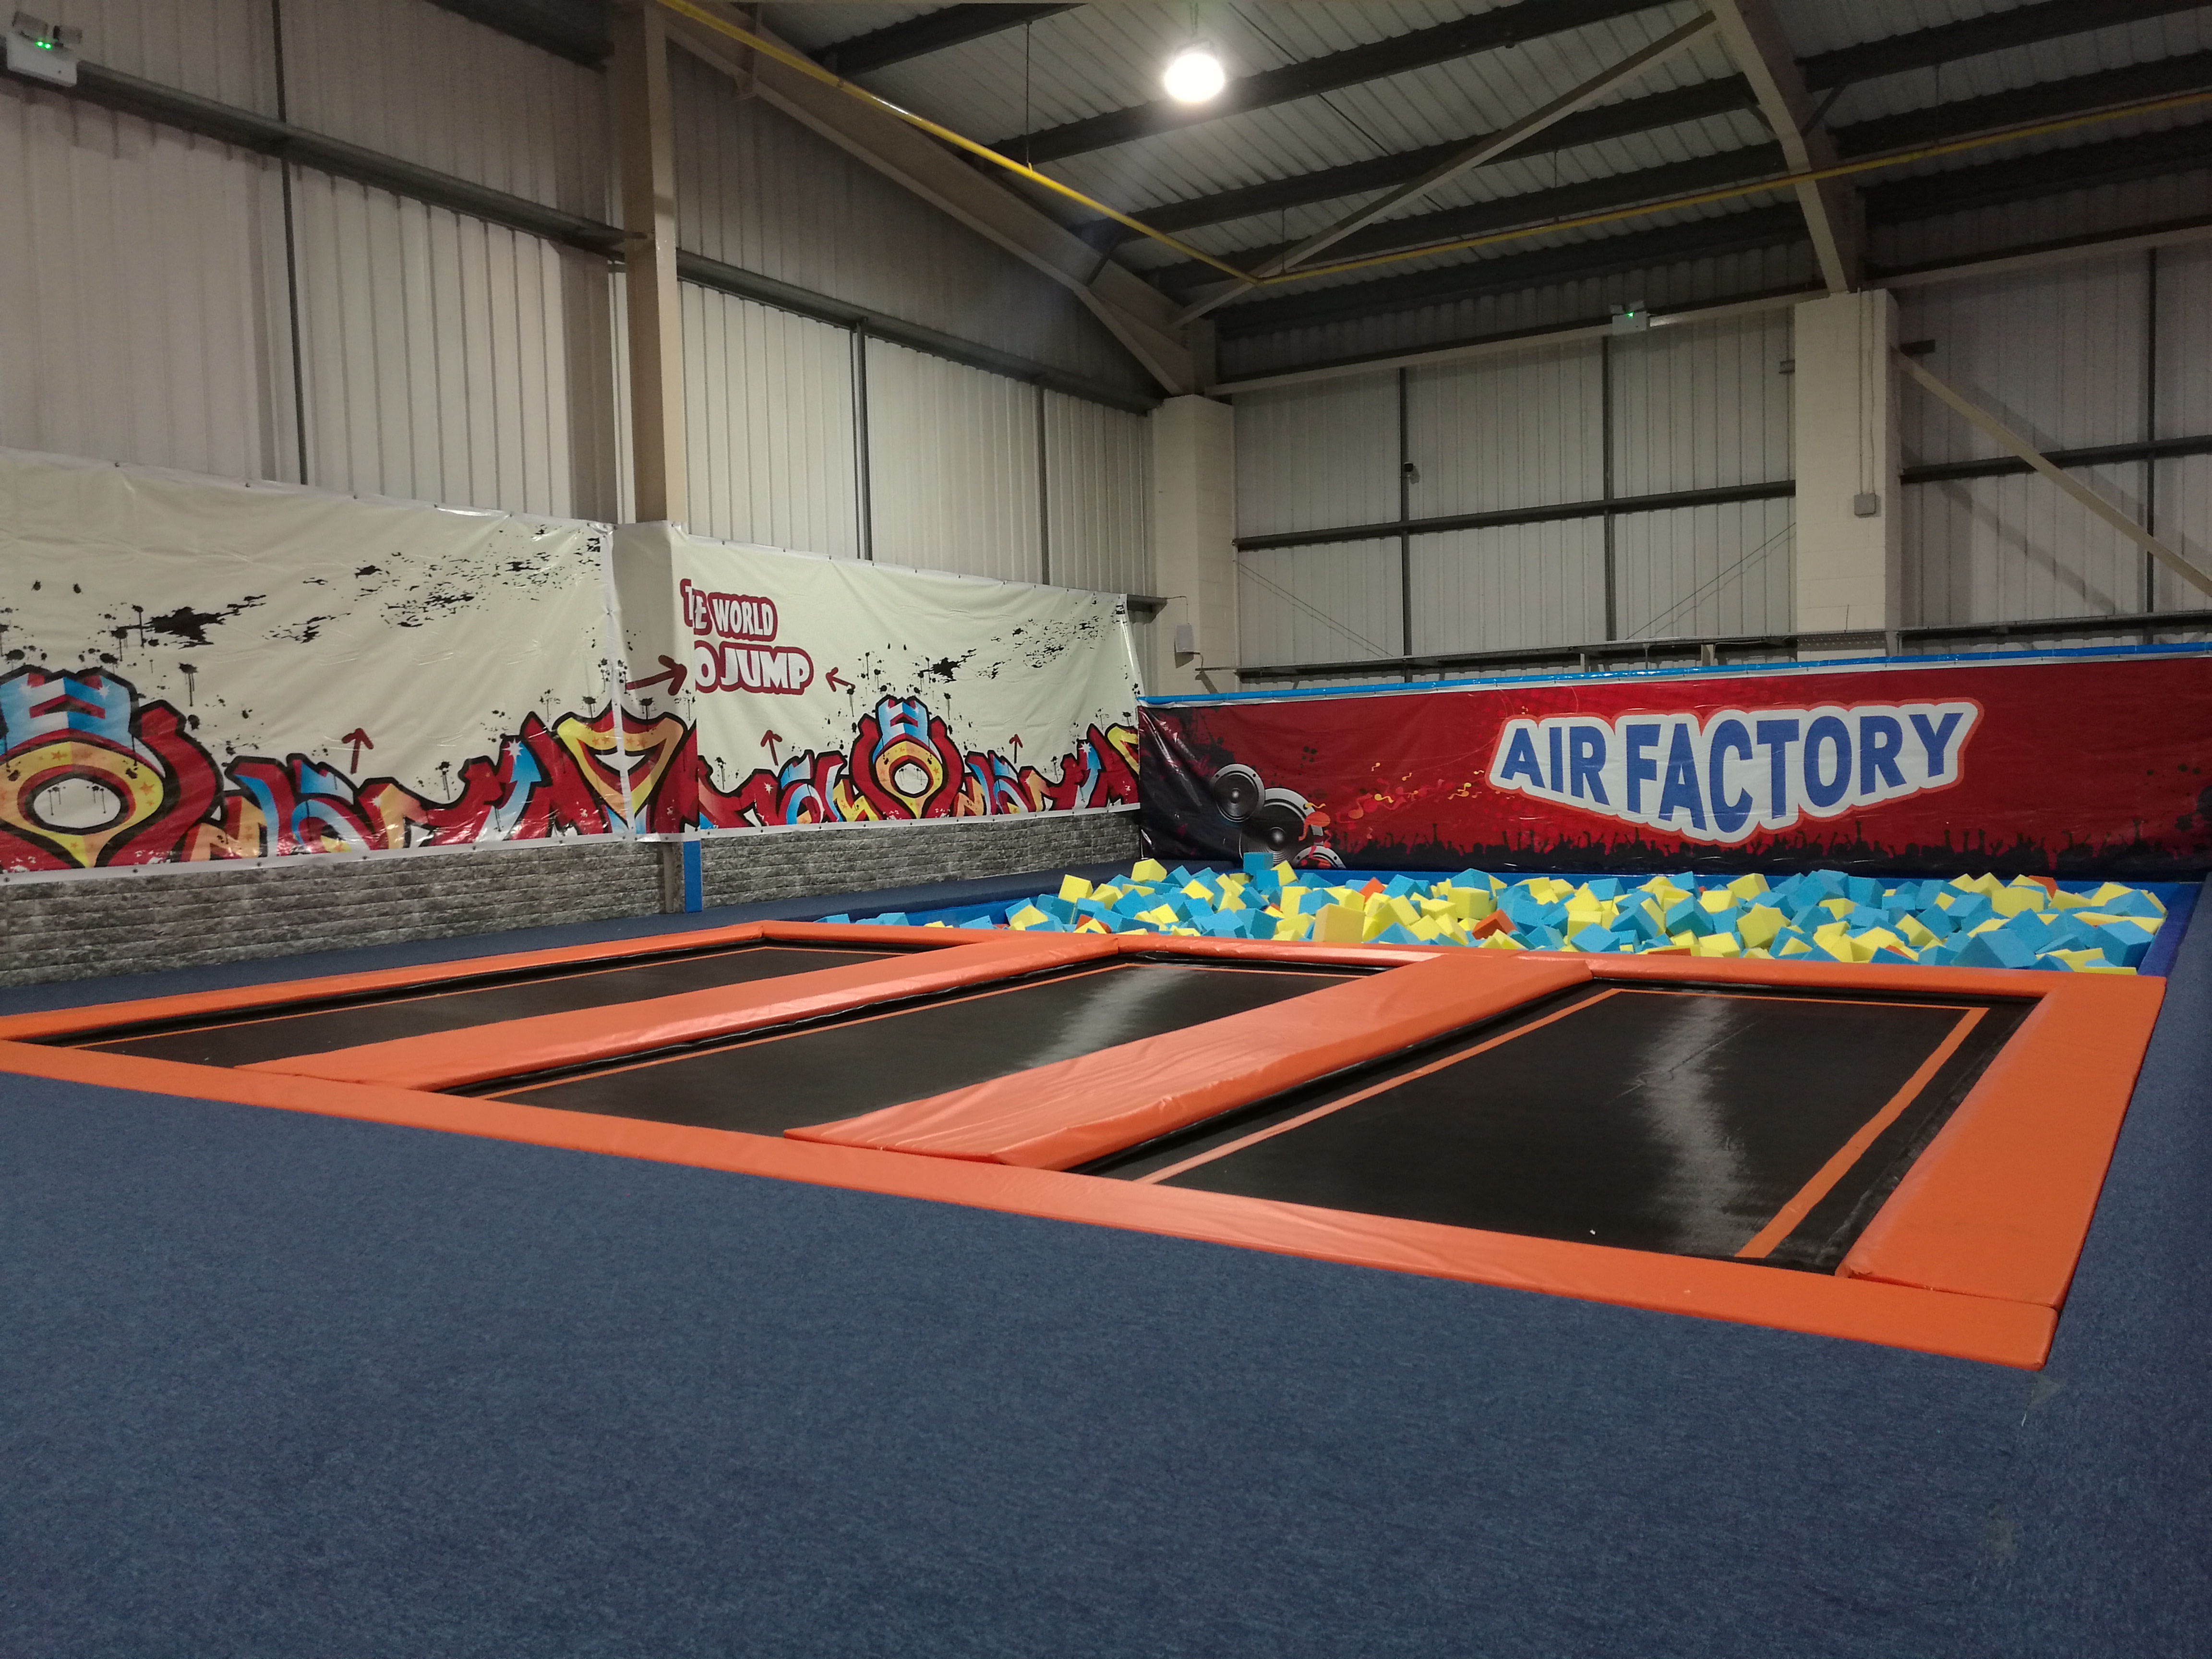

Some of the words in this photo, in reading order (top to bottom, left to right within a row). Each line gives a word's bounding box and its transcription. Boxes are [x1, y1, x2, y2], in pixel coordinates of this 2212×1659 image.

[685, 586, 708, 630] TE
[712, 599, 774, 636] WORLD
[720, 647, 810, 689] JUMP
[1500, 725, 1610, 805] AIR
[1625, 712, 1964, 833] FACTORY
